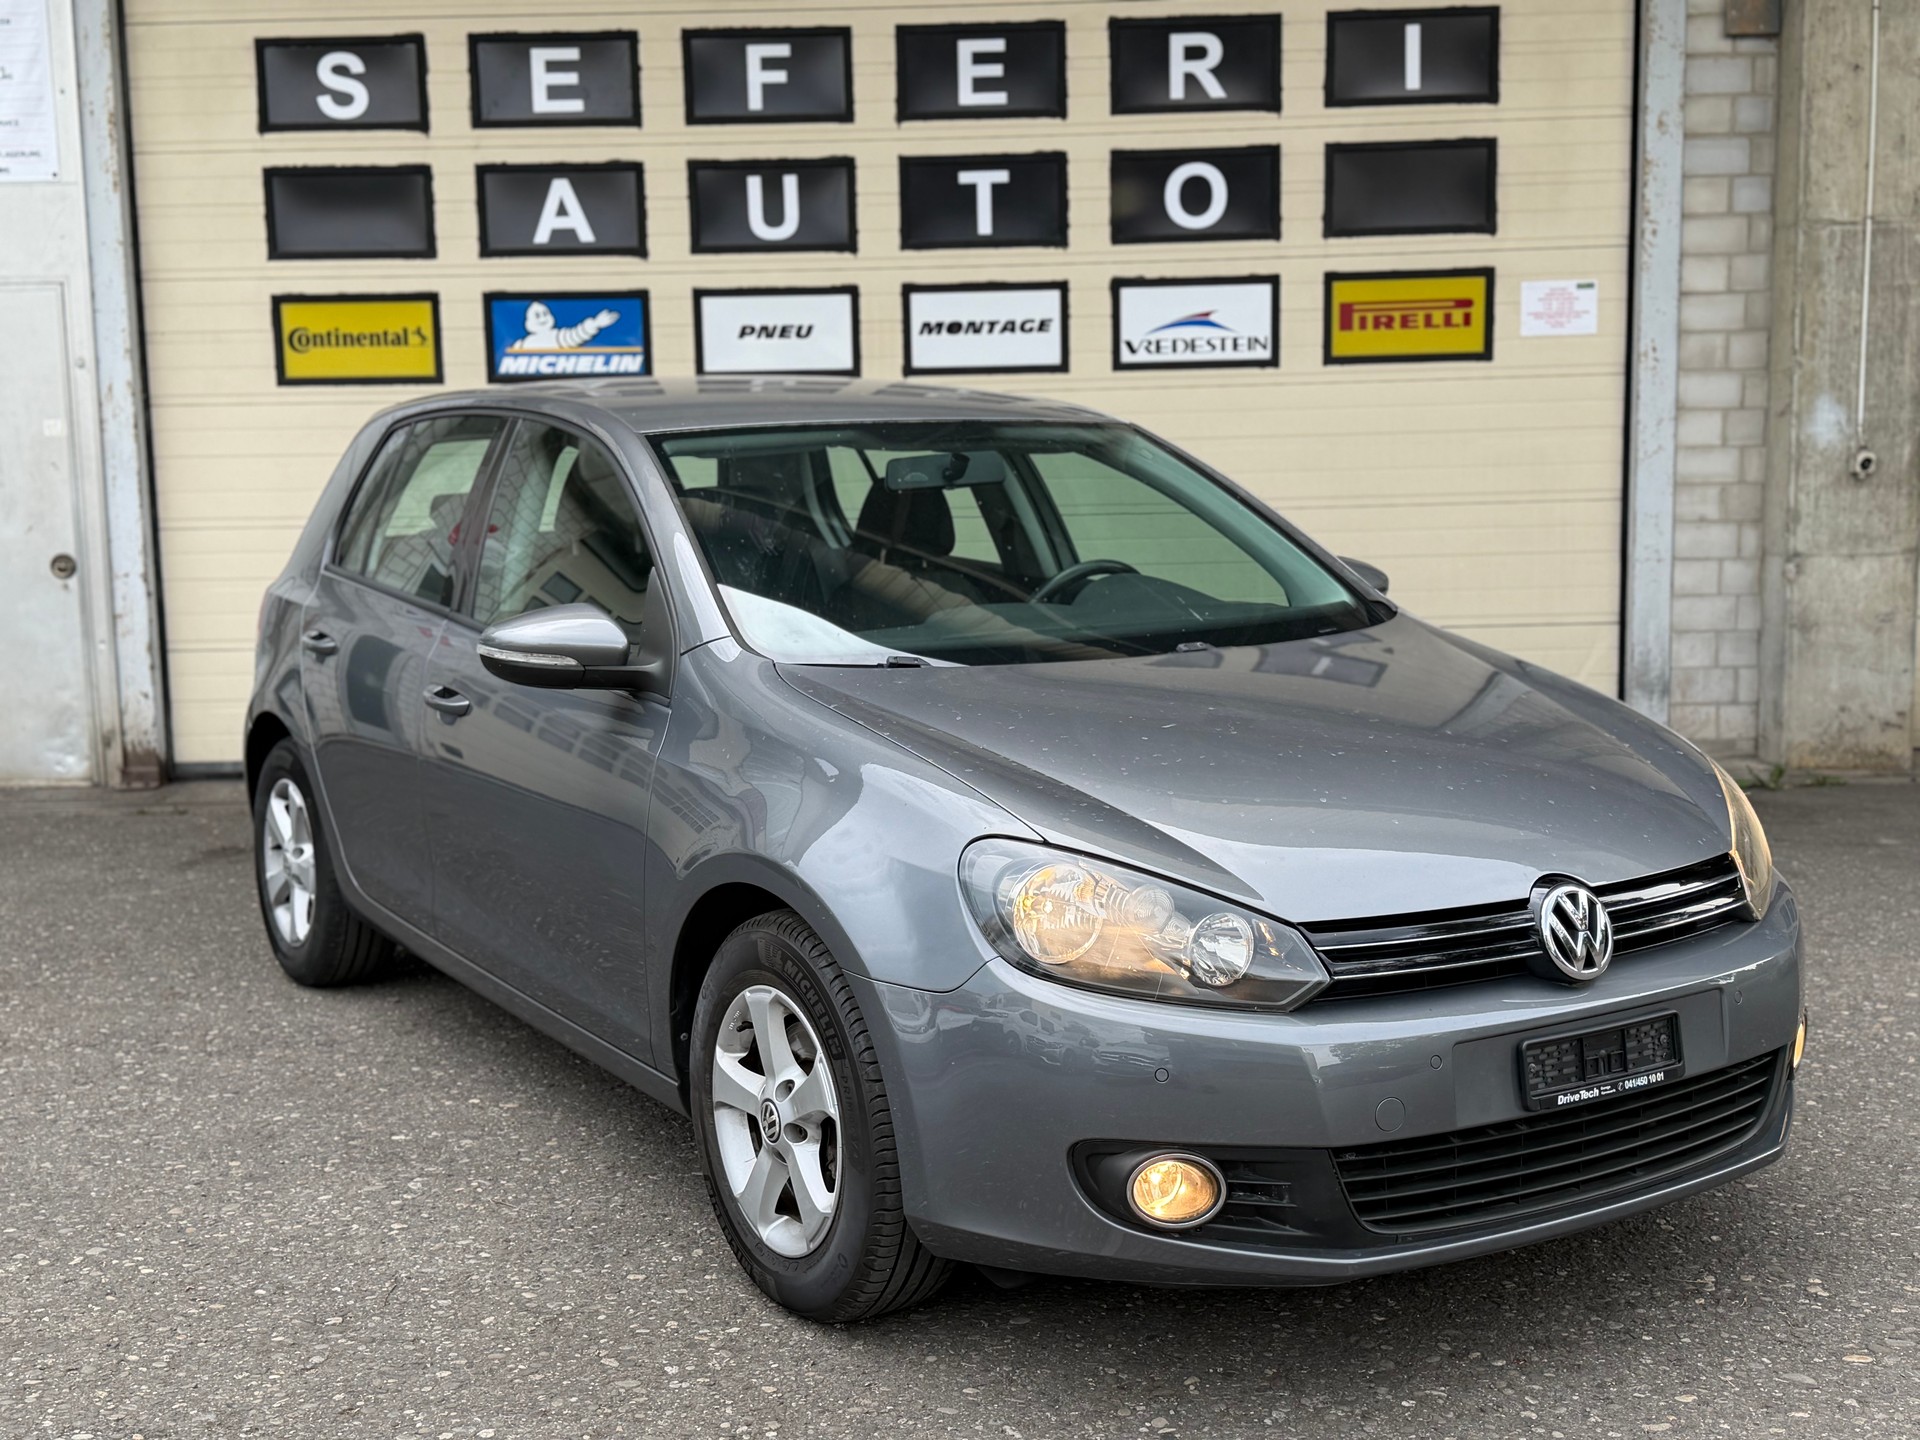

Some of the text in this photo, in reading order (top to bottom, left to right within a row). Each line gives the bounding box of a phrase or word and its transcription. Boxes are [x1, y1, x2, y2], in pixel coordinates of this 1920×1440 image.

[533, 161, 1229, 245] AUTO
[1339, 299, 1474, 332] PIRELLI
[738, 324, 814, 339] PNEU
[919, 318, 1053, 336] MONTAGE
[288, 327, 409, 355] Continental
[1124, 336, 1269, 355] VREDESTEIN
[498, 354, 645, 375] MICHELIN
[783, 960, 844, 1056] MICHELIN
[1557, 1087, 1599, 1105] DriveTech
